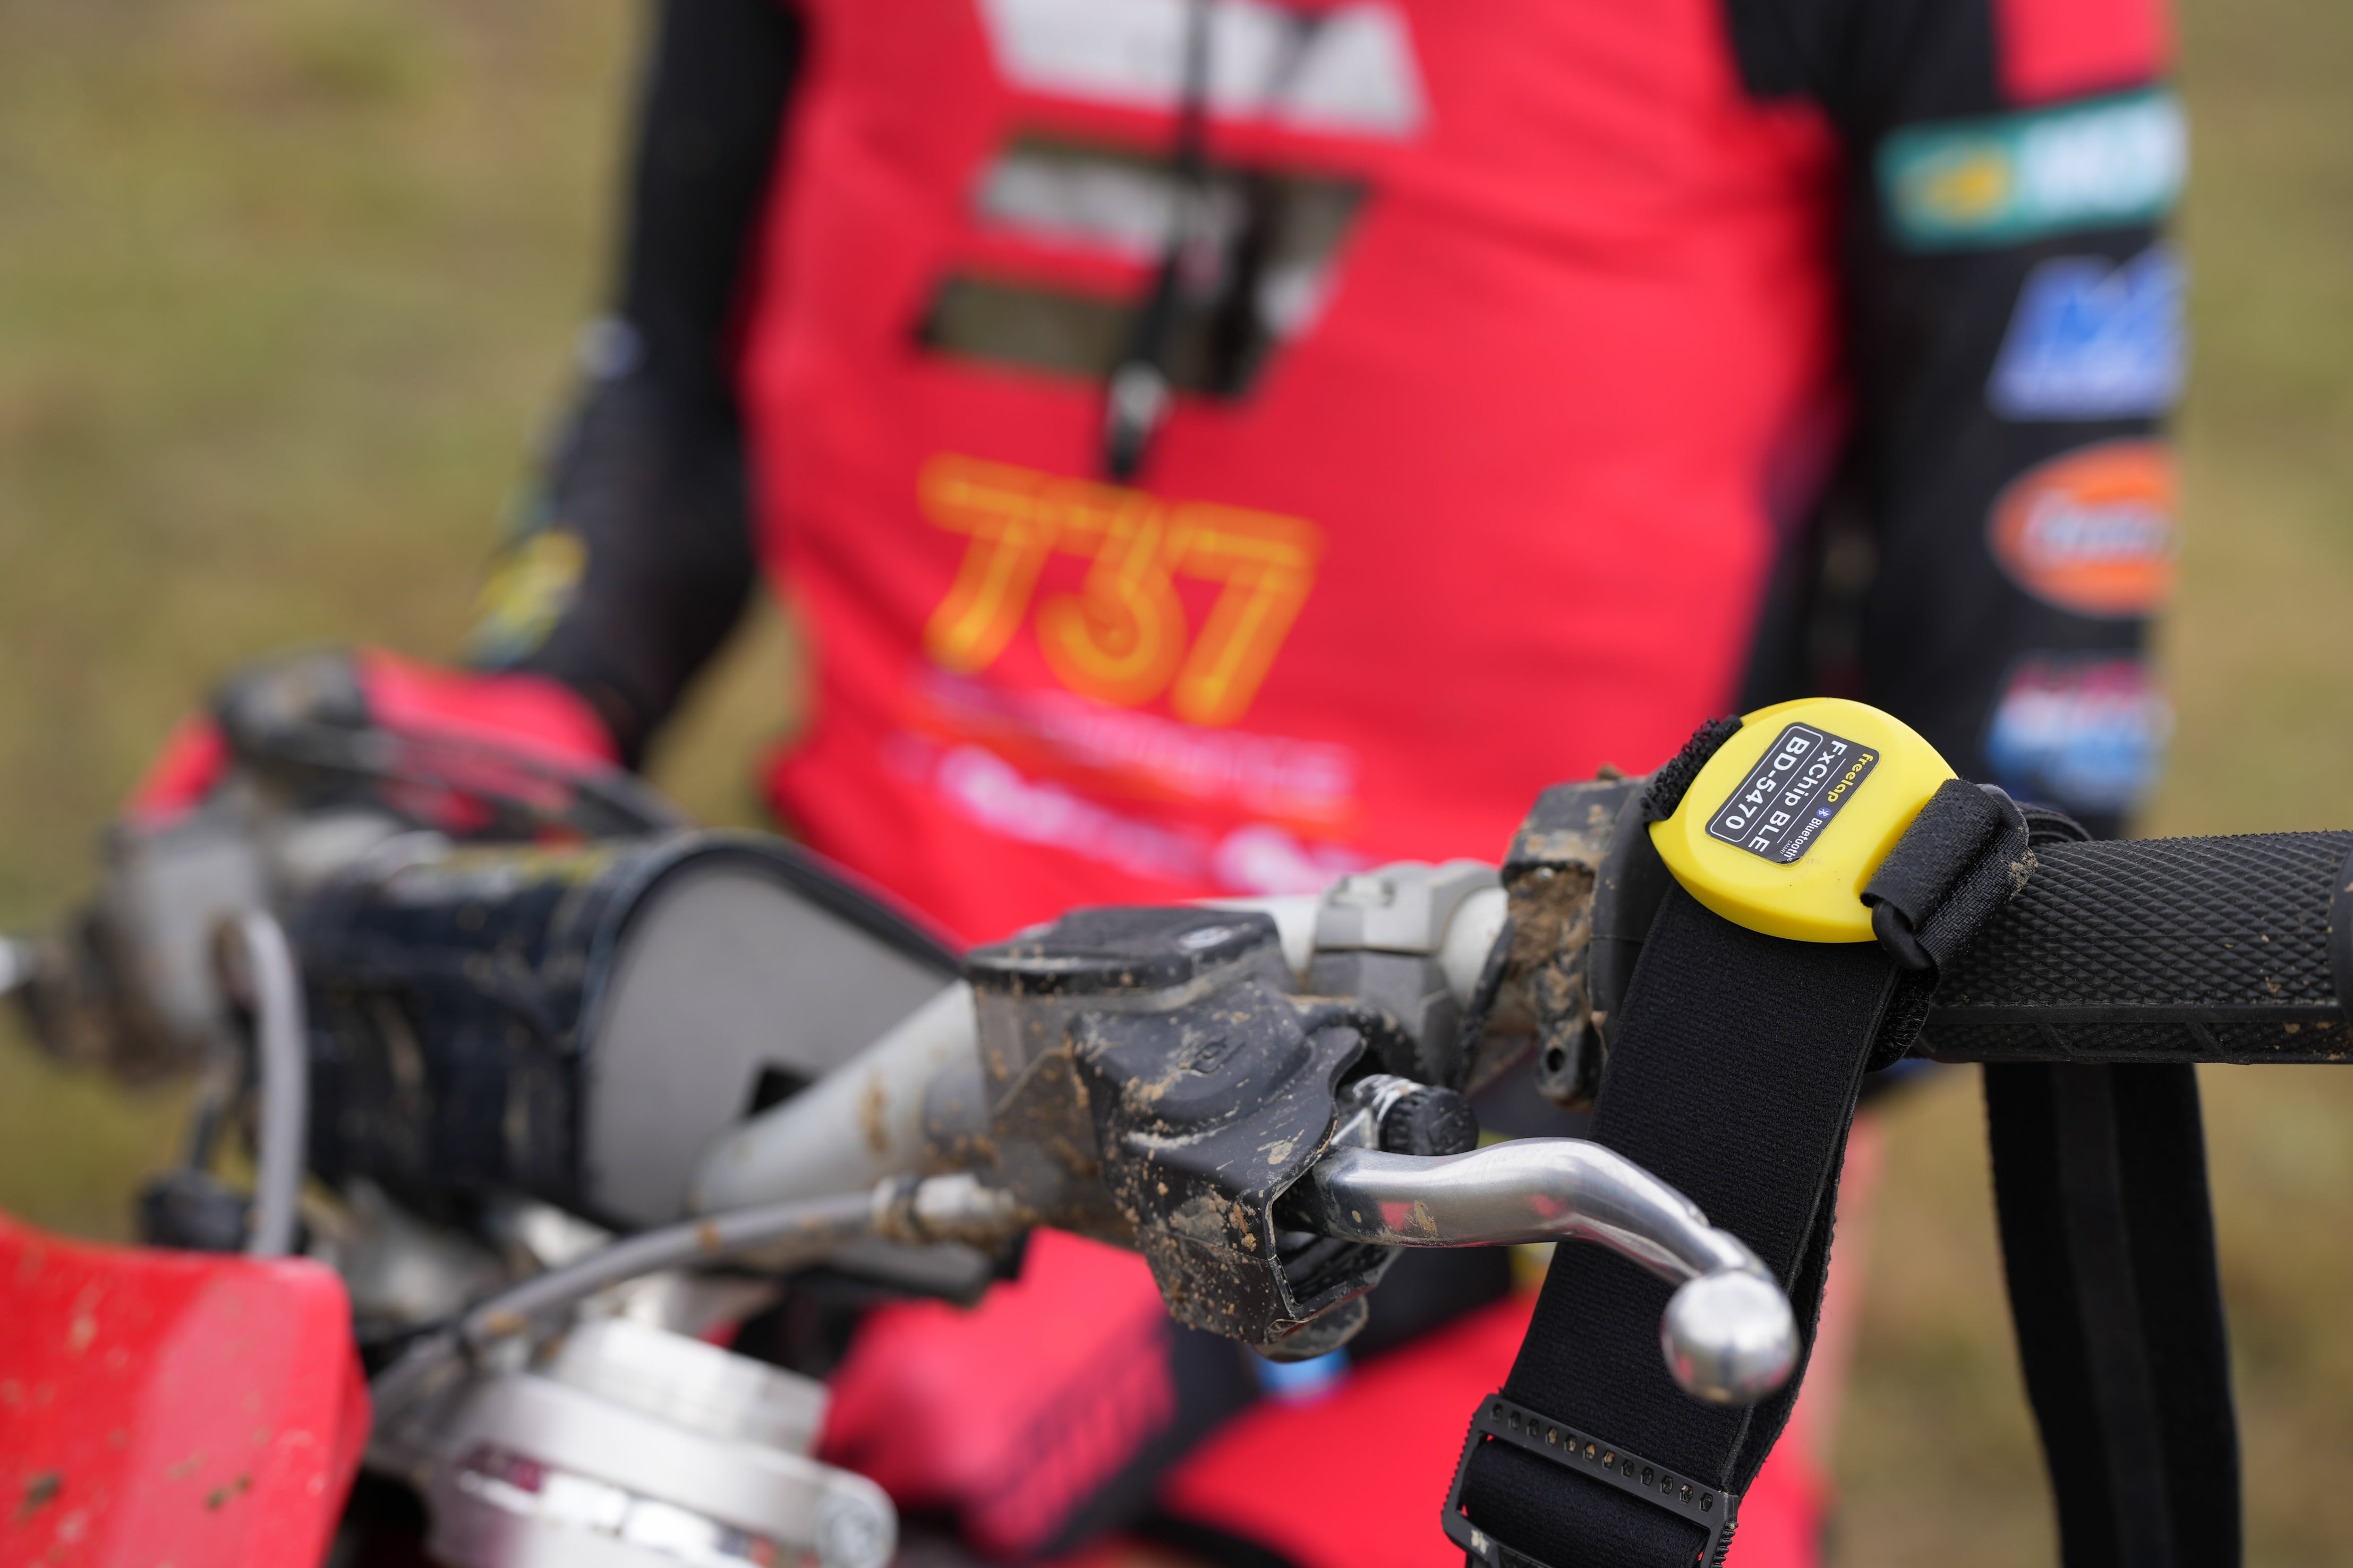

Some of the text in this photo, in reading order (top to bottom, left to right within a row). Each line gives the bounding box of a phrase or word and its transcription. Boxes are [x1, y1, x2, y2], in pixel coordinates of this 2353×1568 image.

[1725, 736, 1810, 829] BD-5470
[1748, 740, 1847, 852] FxChip BLE
[1827, 753, 1873, 802] freelap
[1779, 839, 1793, 854] SMART
